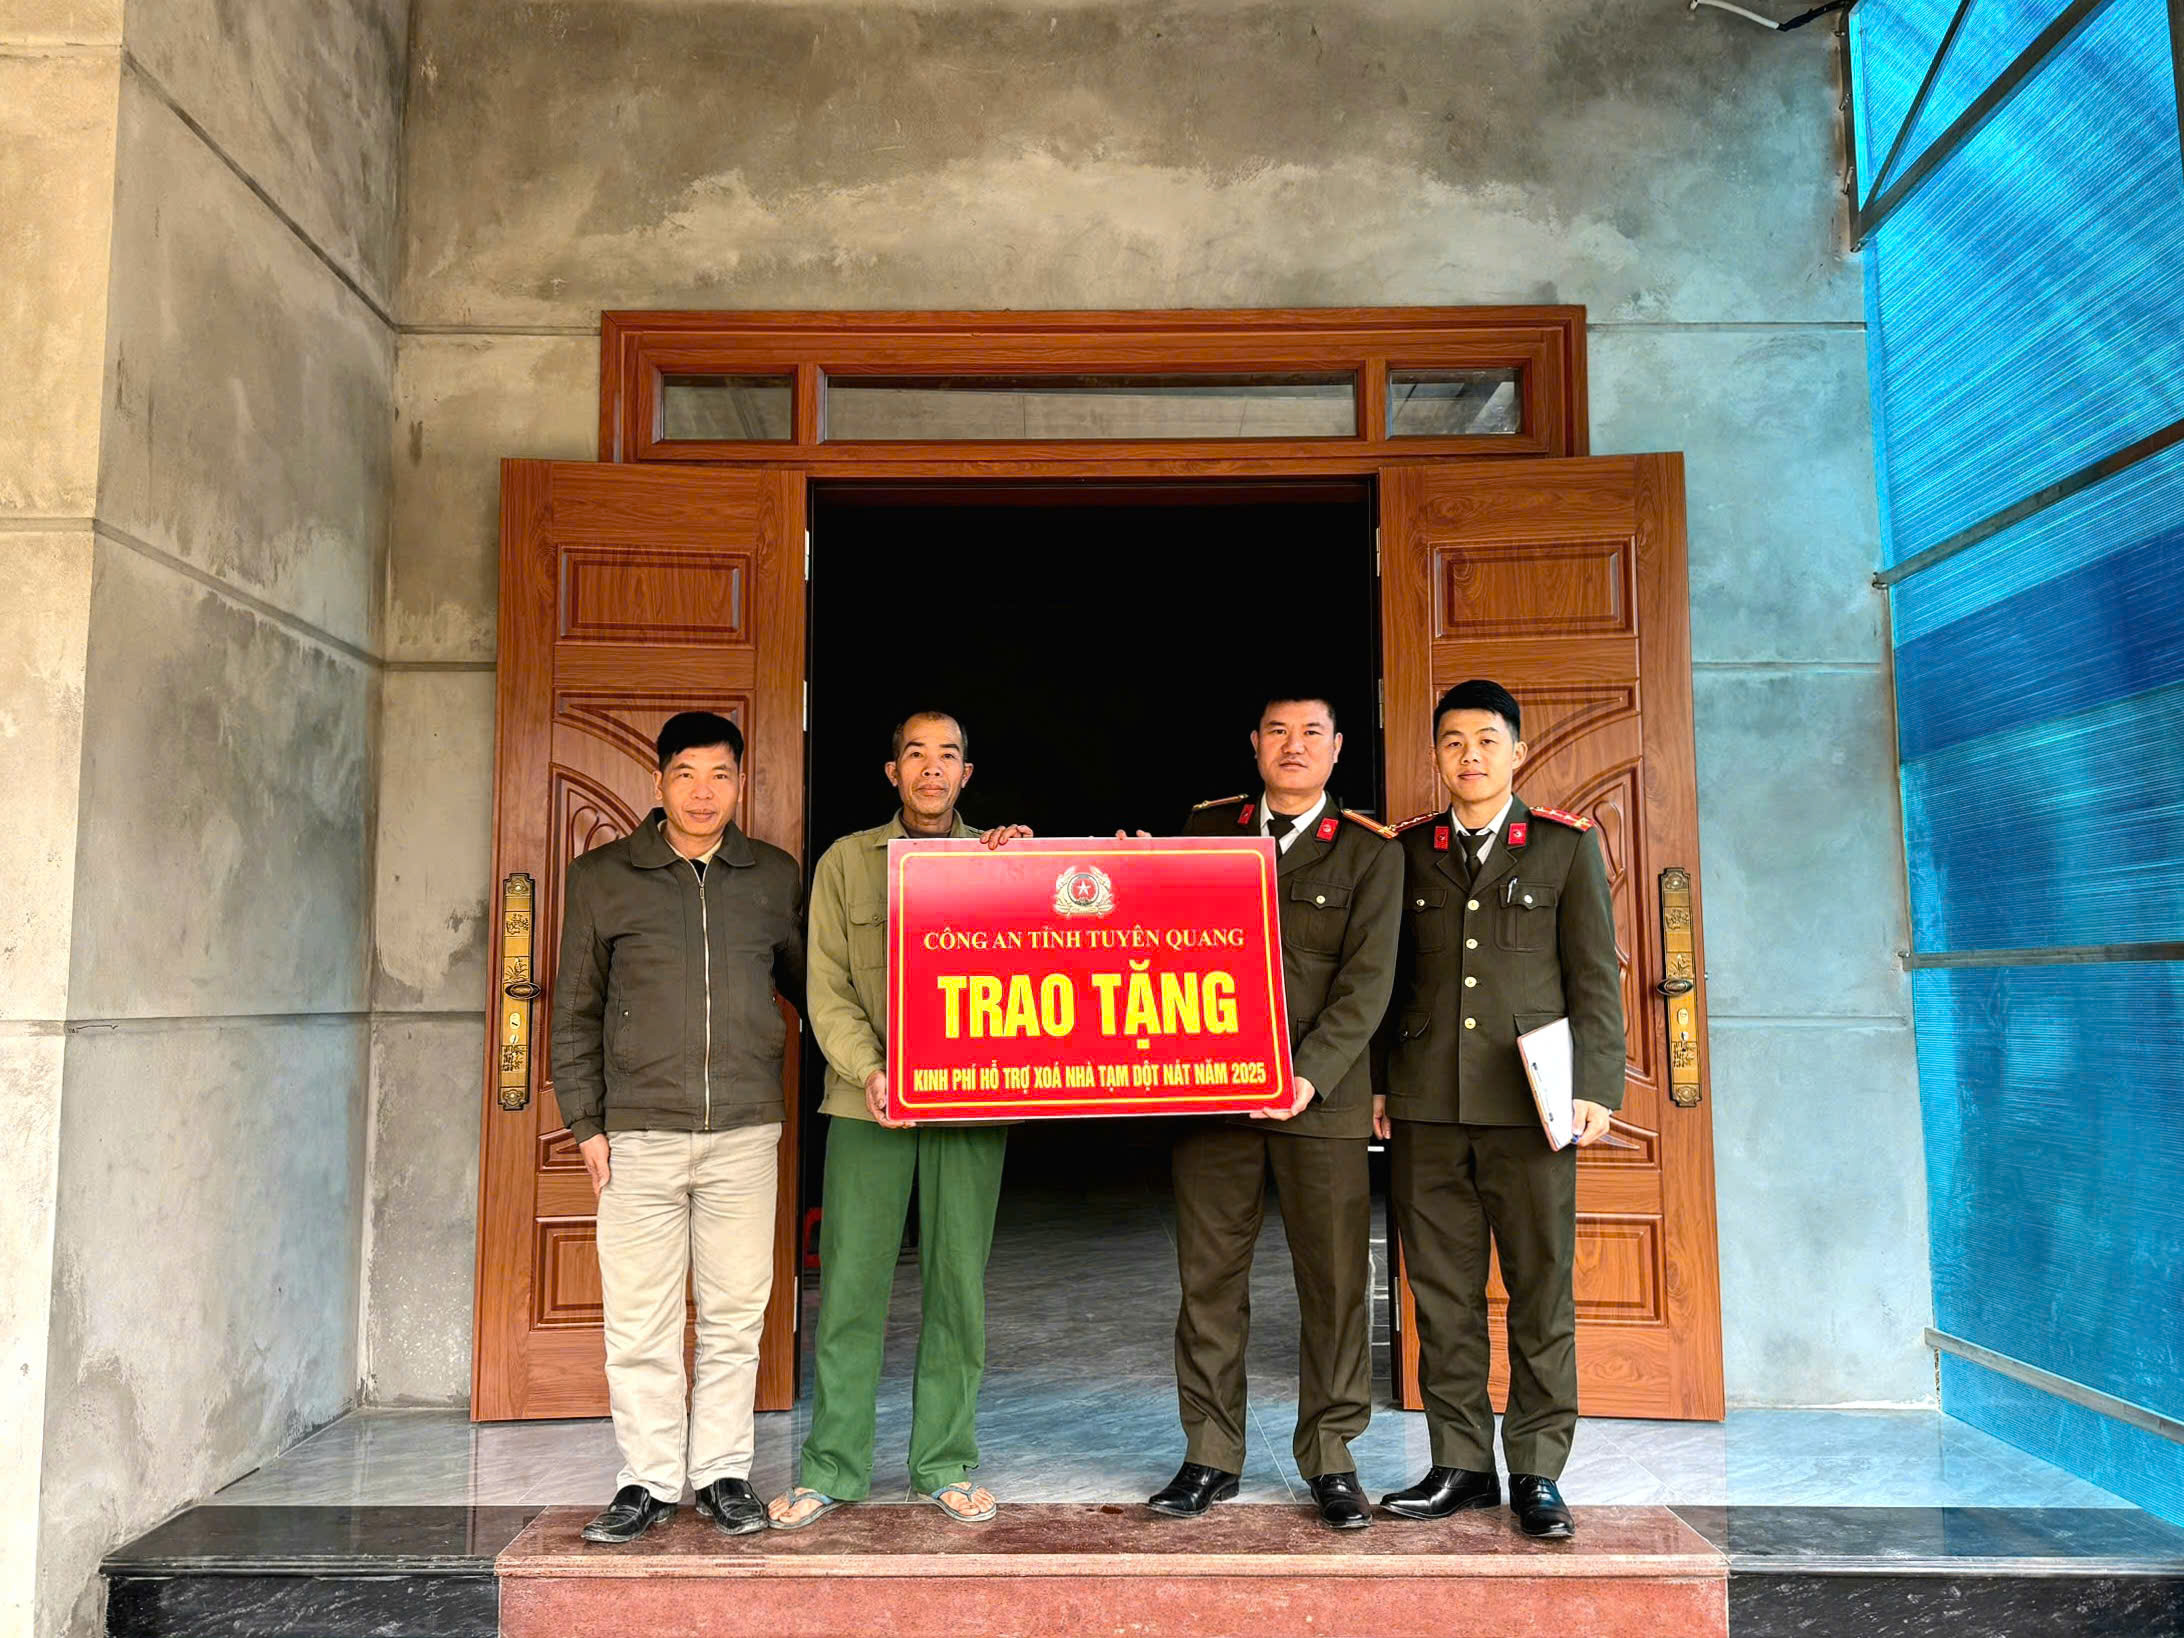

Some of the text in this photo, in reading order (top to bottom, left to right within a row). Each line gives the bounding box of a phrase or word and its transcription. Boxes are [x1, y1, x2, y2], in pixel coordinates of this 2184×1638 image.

[923, 926, 987, 950] CÔNG
[992, 931, 1022, 949] AN
[1086, 924, 1160, 948] TUYÊN
[1165, 928, 1244, 949] QUANG
[937, 959, 1239, 1049] TRAO TẶNG
[913, 1058, 1266, 1094] KINH PHÍ HỖ TRỢ XOÁ NHÀ TẠM DỘT NÁT NĂM 2025
